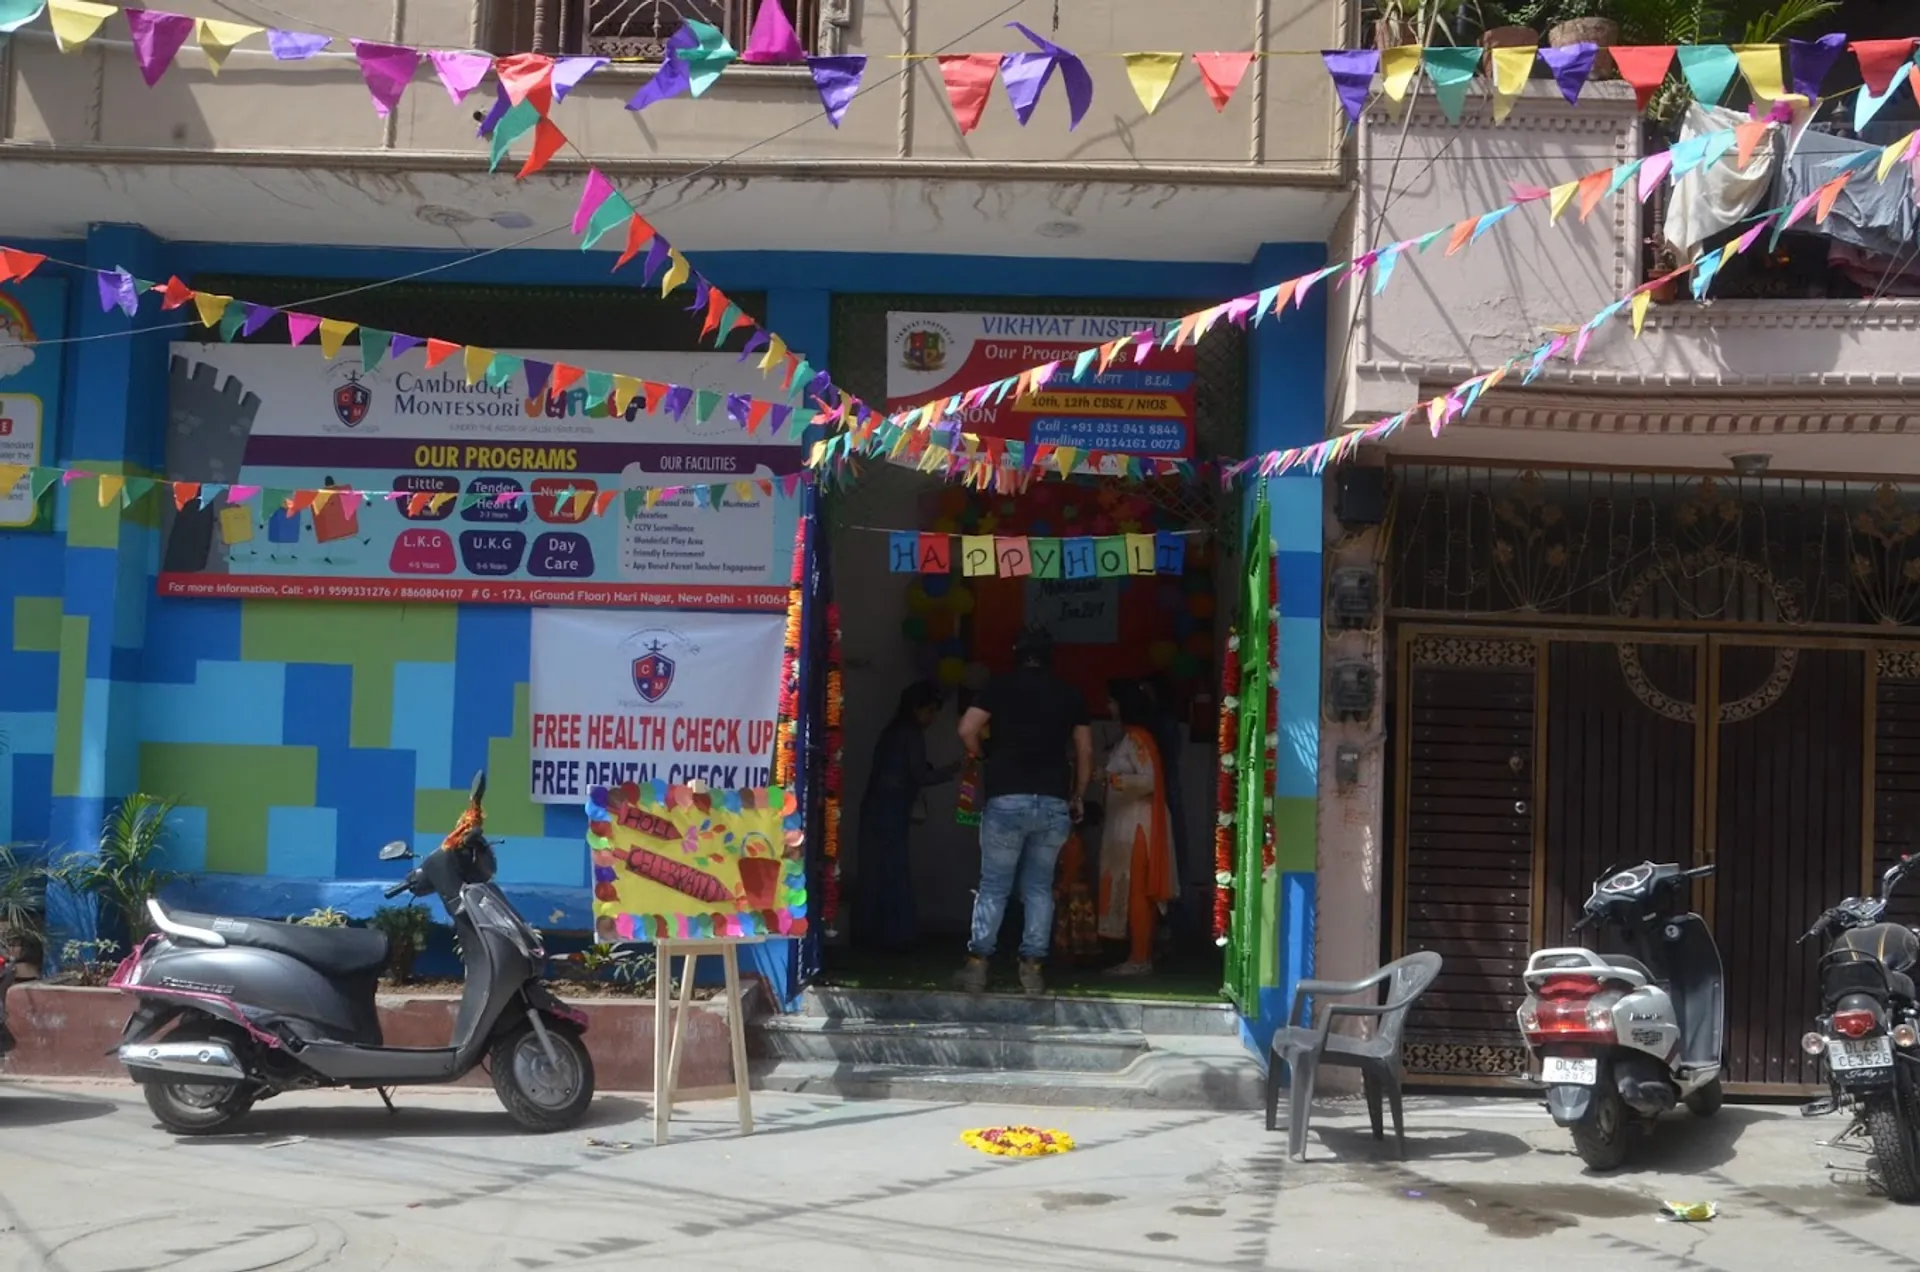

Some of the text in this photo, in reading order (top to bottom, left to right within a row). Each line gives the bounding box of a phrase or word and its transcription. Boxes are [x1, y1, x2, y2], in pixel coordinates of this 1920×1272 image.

[982, 316, 1190, 340] VIKHYAT INSTITU
[985, 344, 1017, 361] Our
[1094, 397, 1125, 409] CBSE
[1136, 399, 1168, 411] NIOS
[1037, 421, 1061, 433] Call
[1071, 424, 1093, 434] +91
[415, 445, 577, 470] OUR PROGRAMS
[660, 456, 736, 472] OUR FACILITIES
[407, 478, 445, 490] Little
[474, 482, 516, 495] Tender
[403, 536, 441, 548] L.K.G
[473, 538, 512, 549] U.K.G
[549, 539, 576, 554] Day
[544, 559, 579, 570] Care
[168, 582, 185, 592] For
[188, 584, 214, 592] more
[307, 586, 325, 595] +91
[678, 594, 701, 602] New
[706, 595, 733, 603] Delhi
[533, 713, 774, 755] FREE HEALTH CHECK UP
[531, 760, 579, 795] FREE
